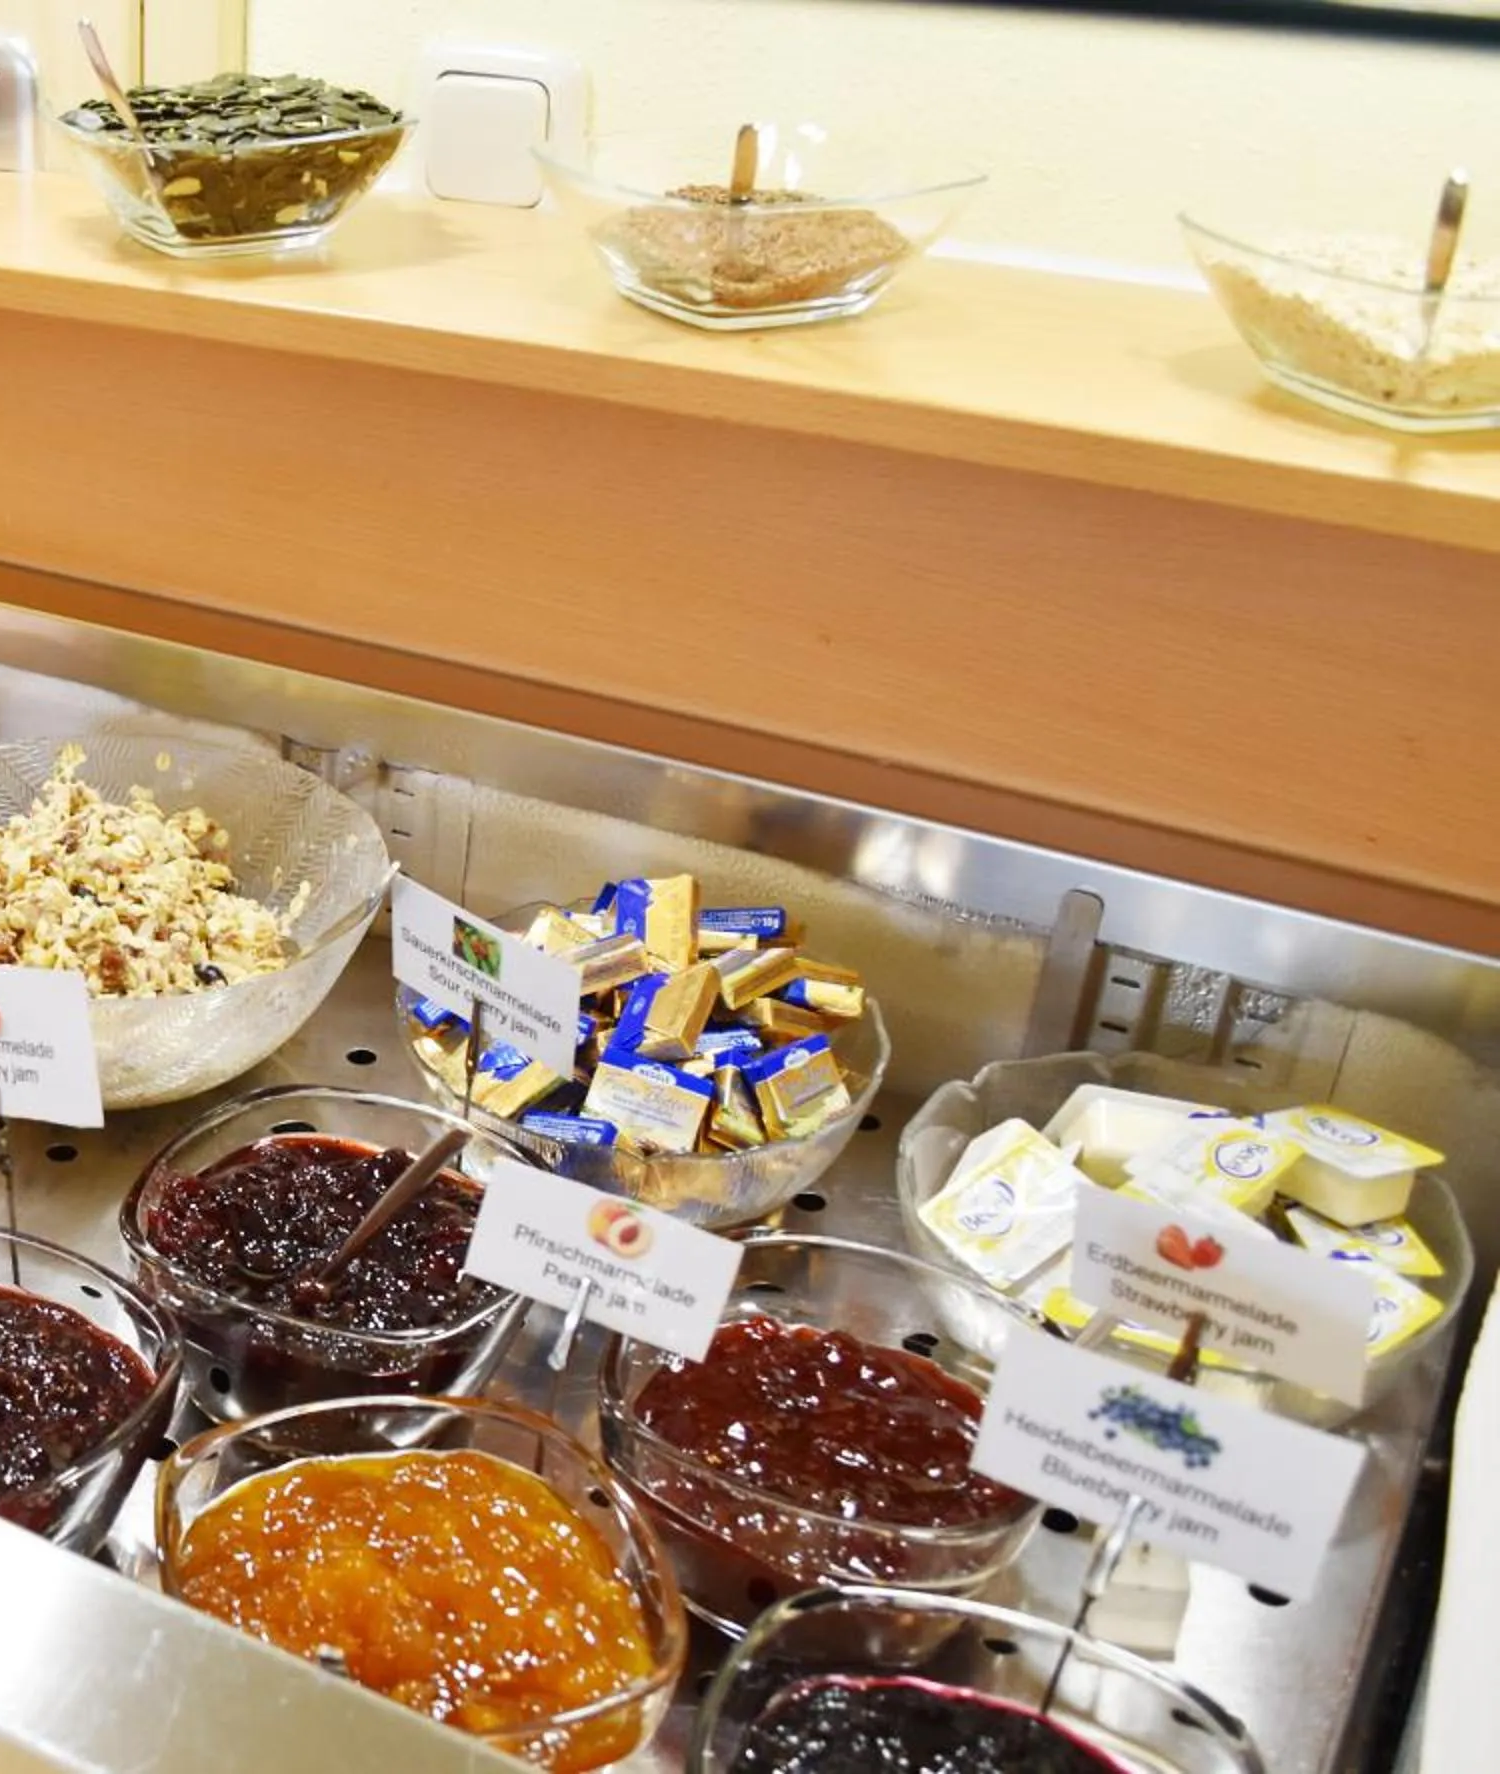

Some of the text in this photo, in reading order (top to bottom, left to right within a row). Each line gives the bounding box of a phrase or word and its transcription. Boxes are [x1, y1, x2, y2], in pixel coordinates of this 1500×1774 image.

[401, 927, 562, 1034] Sauerkirschmarmelade
[428, 964, 460, 993] Sour
[509, 1010, 539, 1042] jam
[12, 1065, 40, 1085] jam
[542, 1261, 605, 1299] Peah
[1086, 1241, 1298, 1335] Erdbeermarmelade
[1231, 1325, 1276, 1356] jam
[1004, 1407, 1295, 1539] Heidelbeermarmelade
[1166, 1508, 1221, 1544] jam
